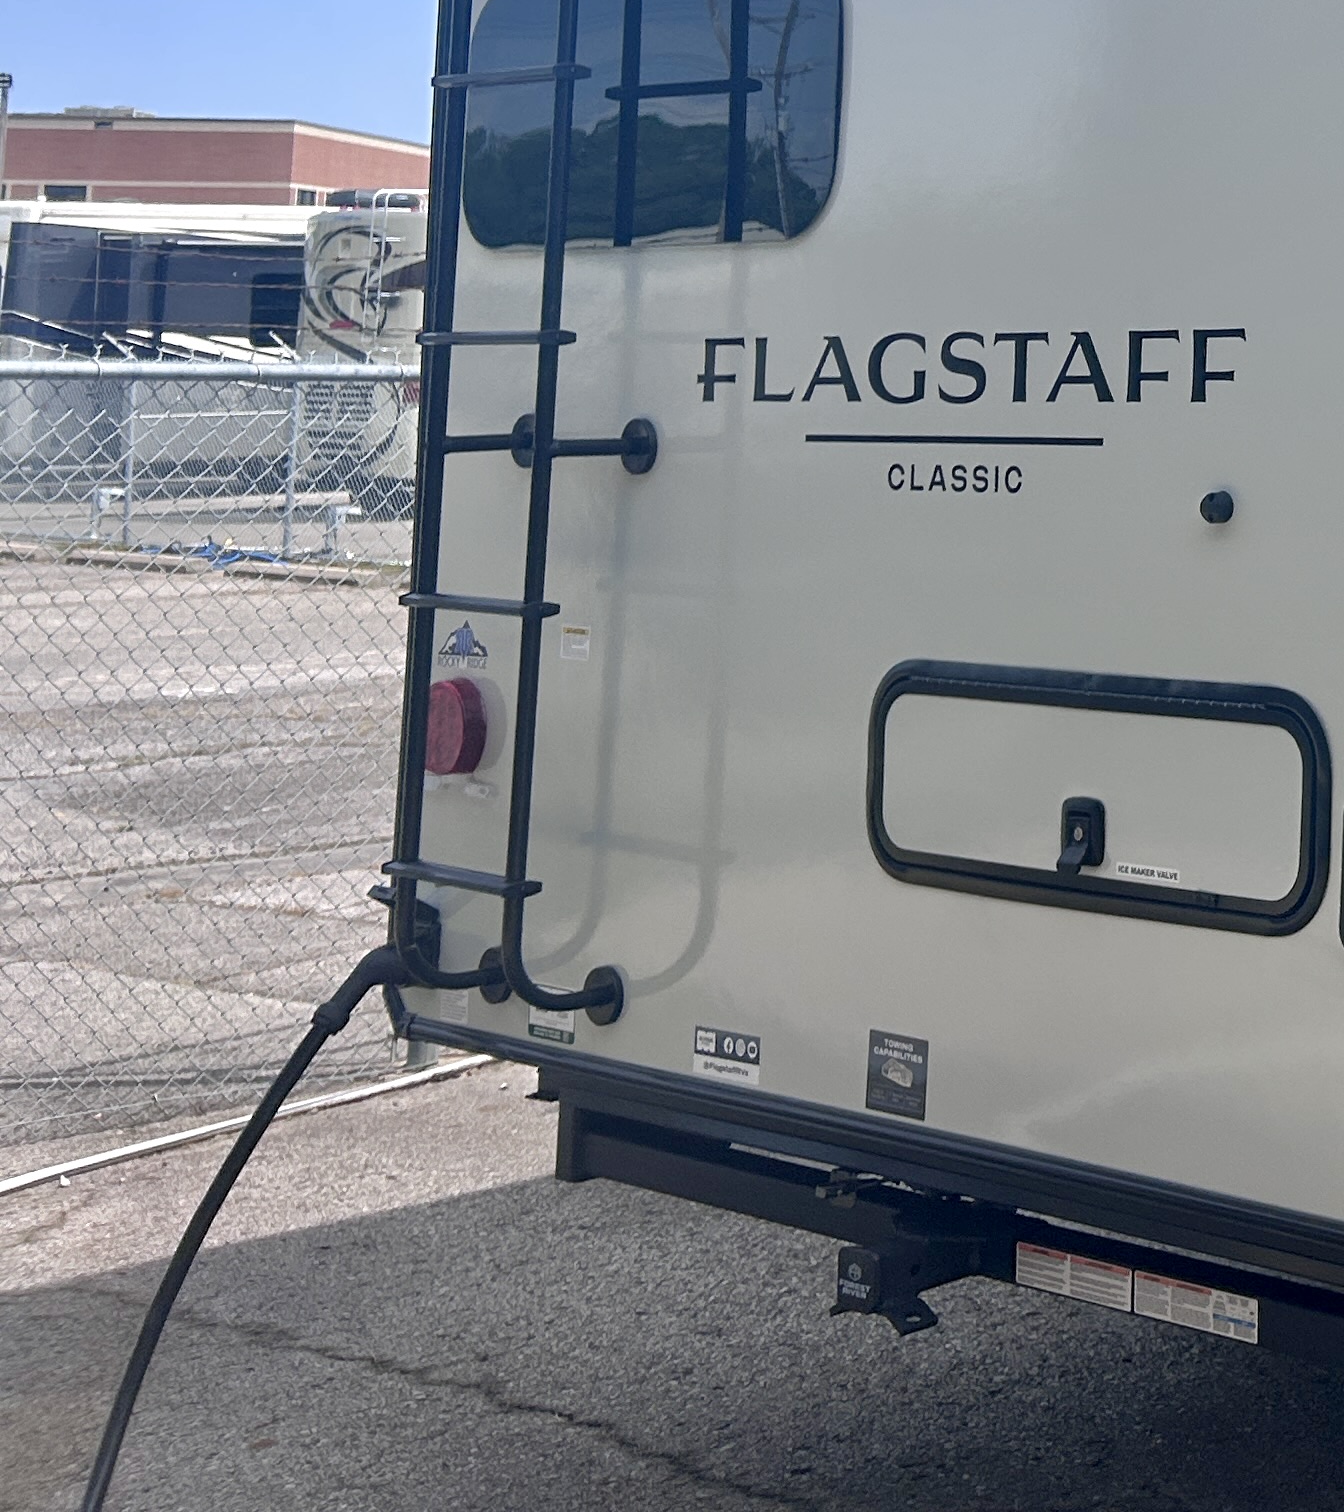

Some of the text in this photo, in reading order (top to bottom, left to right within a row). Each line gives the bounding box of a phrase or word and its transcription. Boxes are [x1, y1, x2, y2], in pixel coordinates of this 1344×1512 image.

[696, 328, 1246, 404] FLAGSTAFF
[887, 463, 1023, 493] CLASSIC
[437, 655, 460, 668] ROCKY
[1118, 865, 1178, 880] ICE MAKER VALVE
[884, 1038, 914, 1053] TOWING
[873, 1046, 923, 1064] CAPABILITIES
